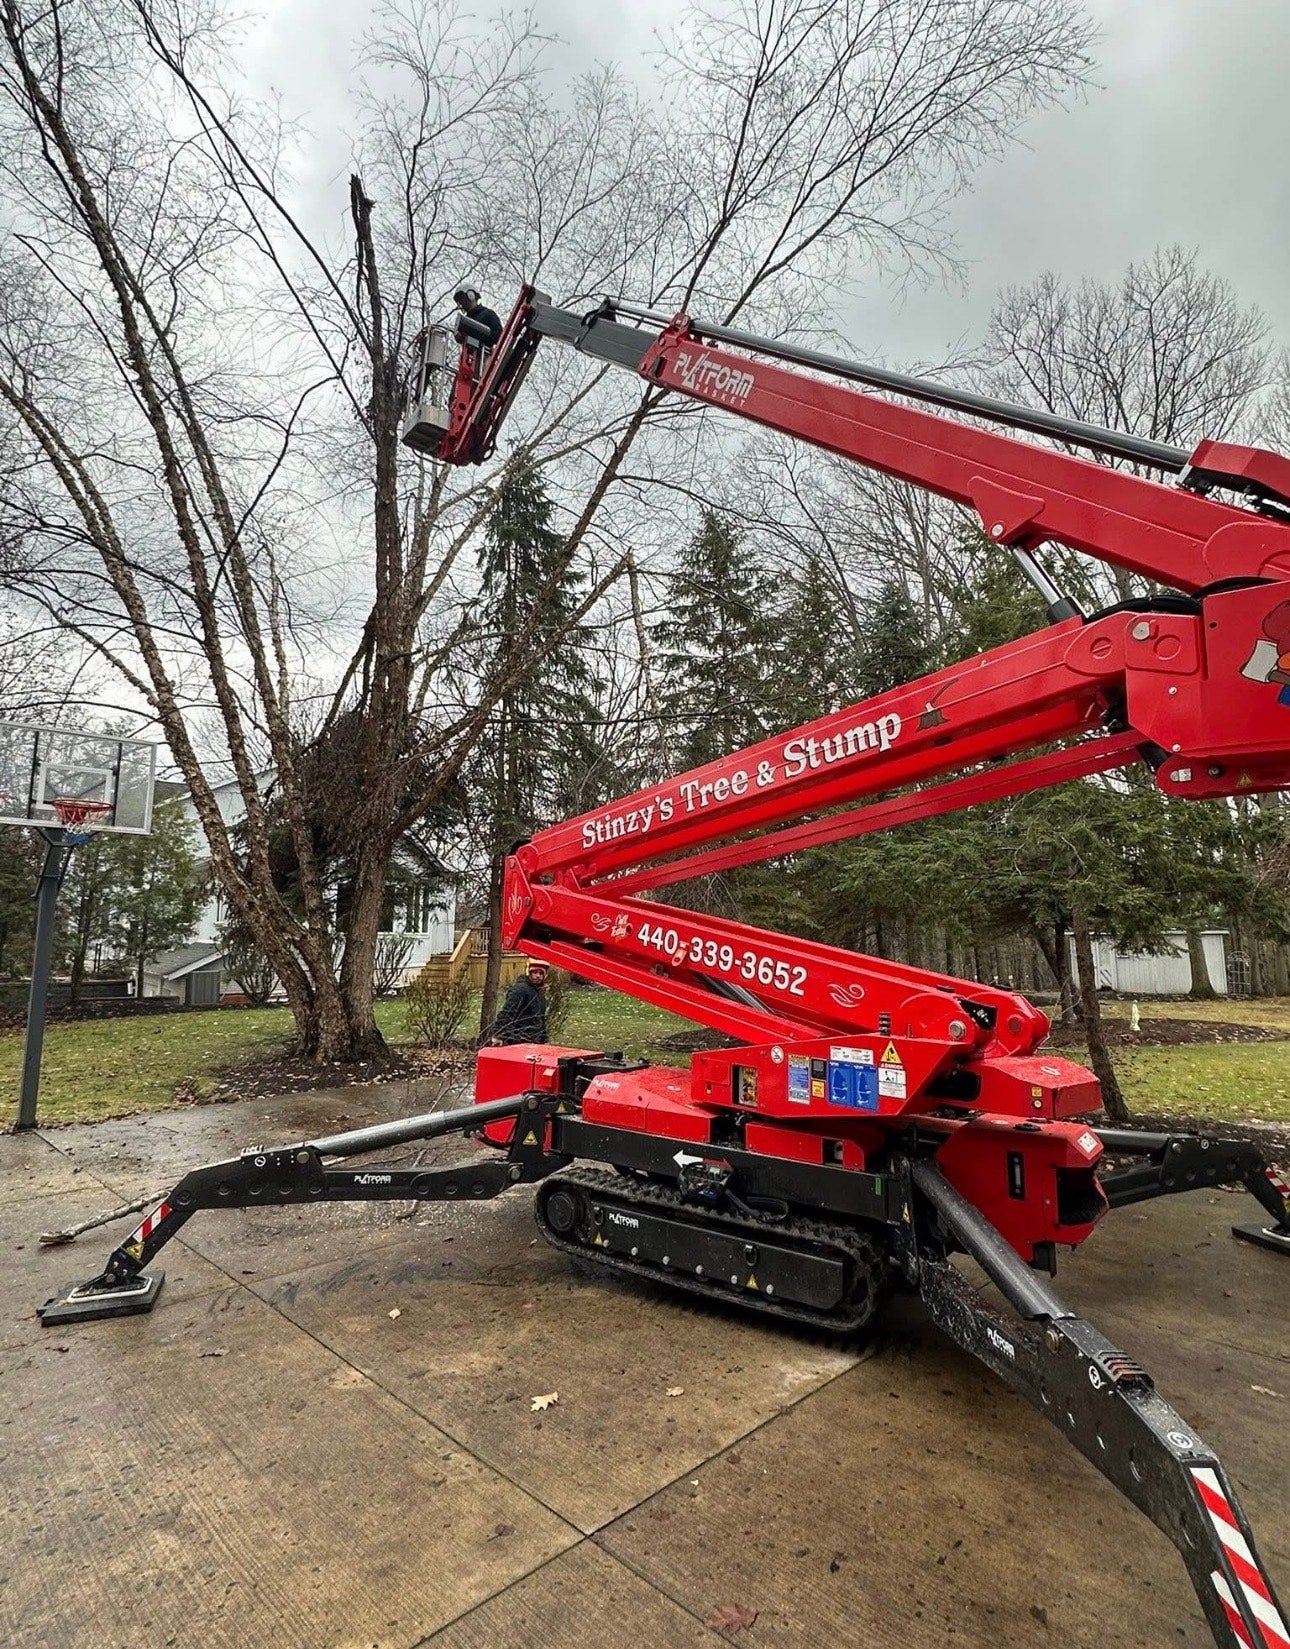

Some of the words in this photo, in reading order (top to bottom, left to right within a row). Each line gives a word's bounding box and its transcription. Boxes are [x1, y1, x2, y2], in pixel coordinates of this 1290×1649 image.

[673, 352, 754, 398] PLATFORM
[581, 797, 673, 848] Stinzy's
[679, 771, 748, 812] Tree
[756, 761, 776, 786] &
[782, 712, 902, 778] Stump
[637, 923, 808, 996] 440-339-3652
